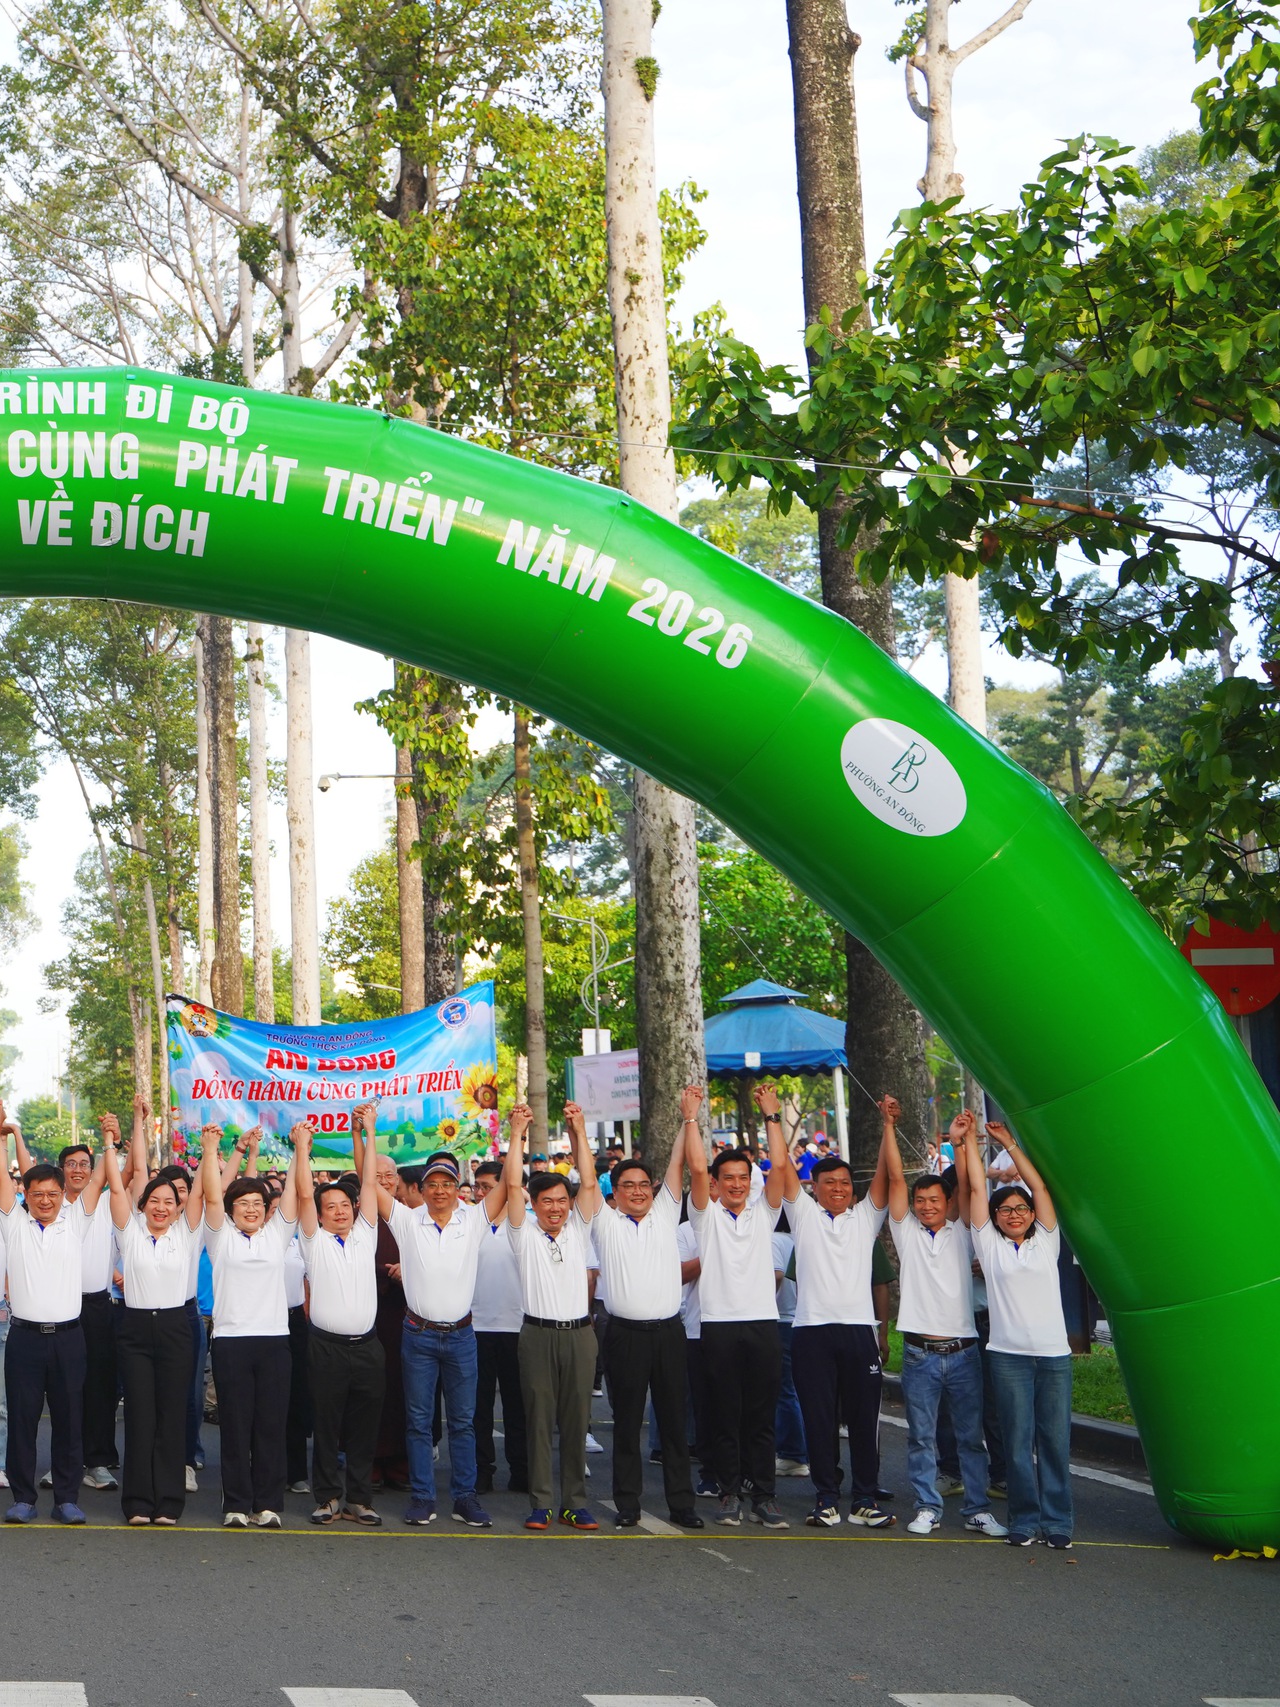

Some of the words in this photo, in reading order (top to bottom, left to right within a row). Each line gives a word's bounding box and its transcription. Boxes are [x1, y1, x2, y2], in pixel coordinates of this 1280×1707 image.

[187, 395, 250, 445] BỘ
[17, 480, 74, 546] VỀ
[90, 493, 210, 558] ĐÍCH
[7, 420, 141, 480] CÙNG
[174, 440, 299, 504] PHÁT
[496, 518, 617, 602] NĂM
[626, 577, 754, 670] 2026
[845, 761, 885, 797] PHƯỜNG
[883, 796, 900, 810] AN
[897, 807, 926, 833] ĐÔNG
[191, 1069, 245, 1100] ĐỒNG
[246, 1075, 303, 1101] HÀNH
[306, 1076, 357, 1101] CÙNG
[361, 1073, 412, 1099] PHÁT
[416, 1060, 464, 1095] TRIỂN
[265, 1048, 308, 1071] AN
[306, 1112, 350, 1132] 202
